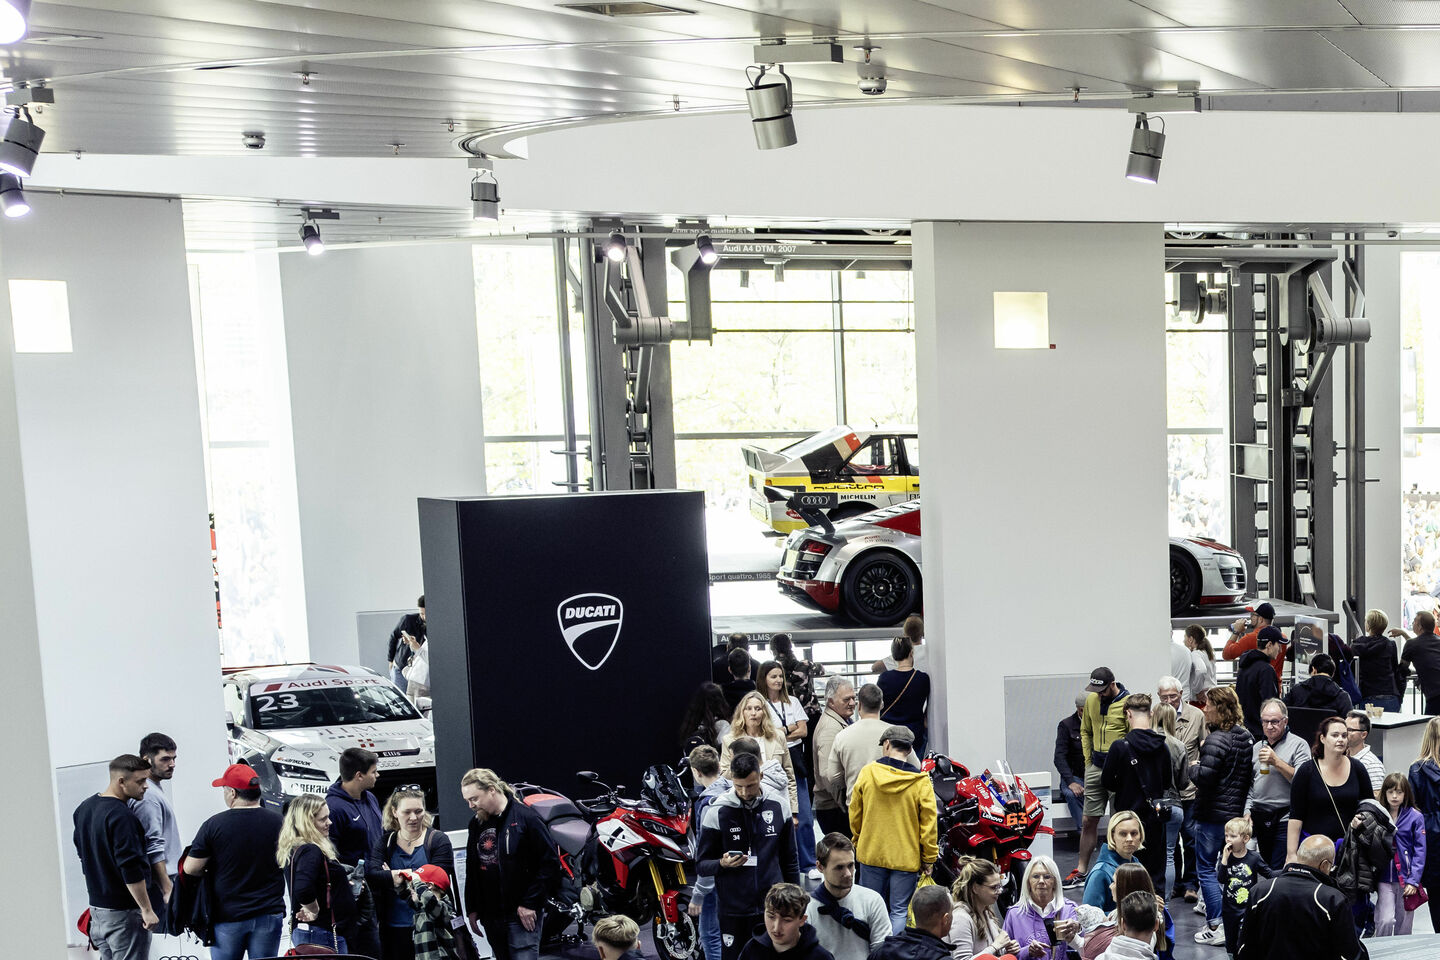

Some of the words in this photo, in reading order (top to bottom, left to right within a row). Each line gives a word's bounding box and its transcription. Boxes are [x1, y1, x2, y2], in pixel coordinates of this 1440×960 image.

[722, 245, 742, 253] Audi
[743, 245, 754, 253] A4
[778, 245, 797, 253] 2007
[565, 604, 616, 620] DUCATI
[287, 678, 328, 689] Audi
[331, 678, 380, 687] Sport
[256, 693, 300, 713] 23
[982, 812, 1003, 823] Lenovo
[1006, 812, 1028, 827] 63
